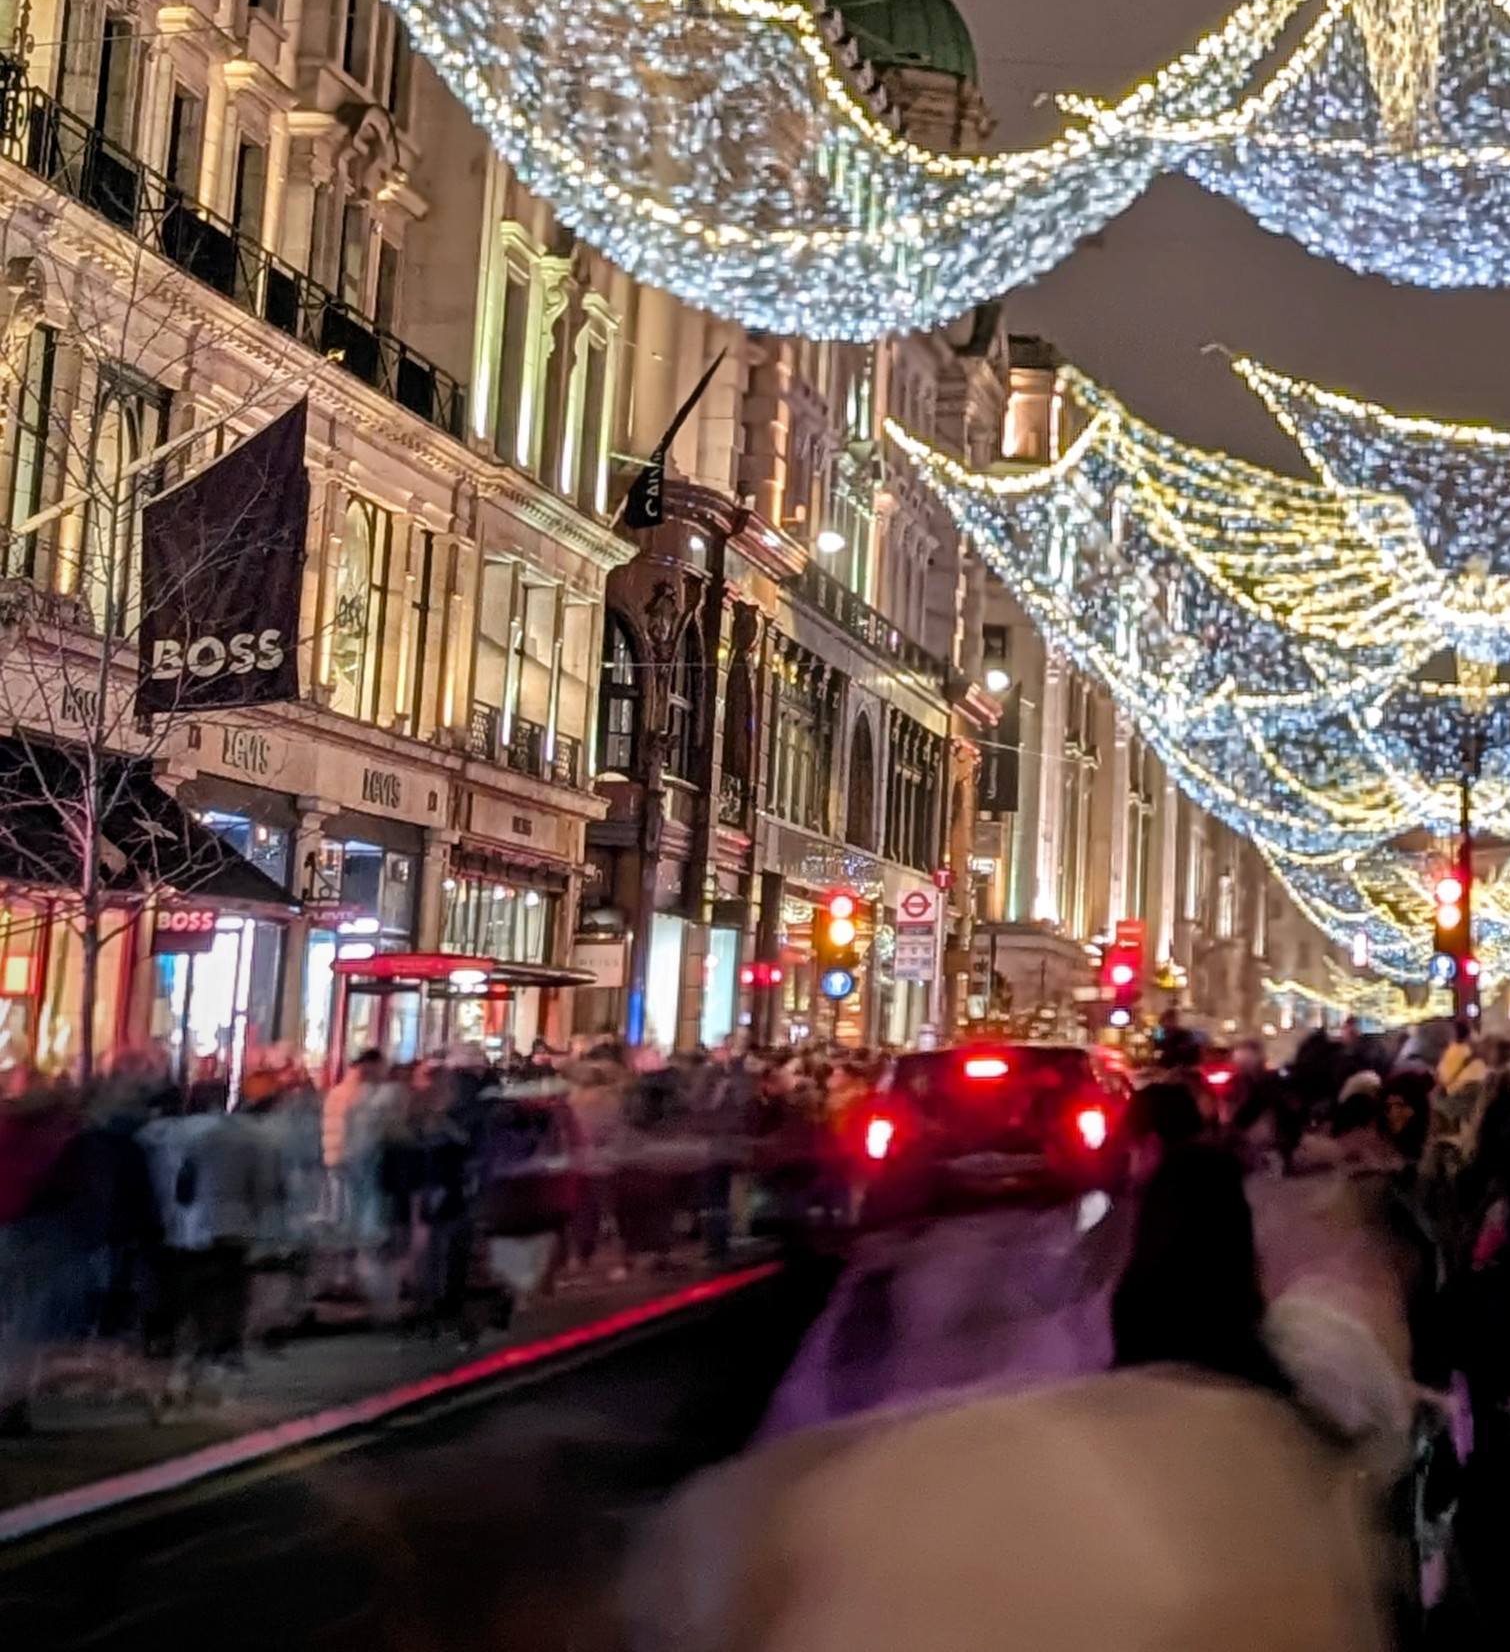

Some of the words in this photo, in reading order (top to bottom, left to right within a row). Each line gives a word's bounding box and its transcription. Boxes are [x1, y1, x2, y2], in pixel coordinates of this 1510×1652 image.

[152, 629, 284, 680] BOSS
[937, 870, 950, 888] T
[157, 911, 214, 931] BOSS
